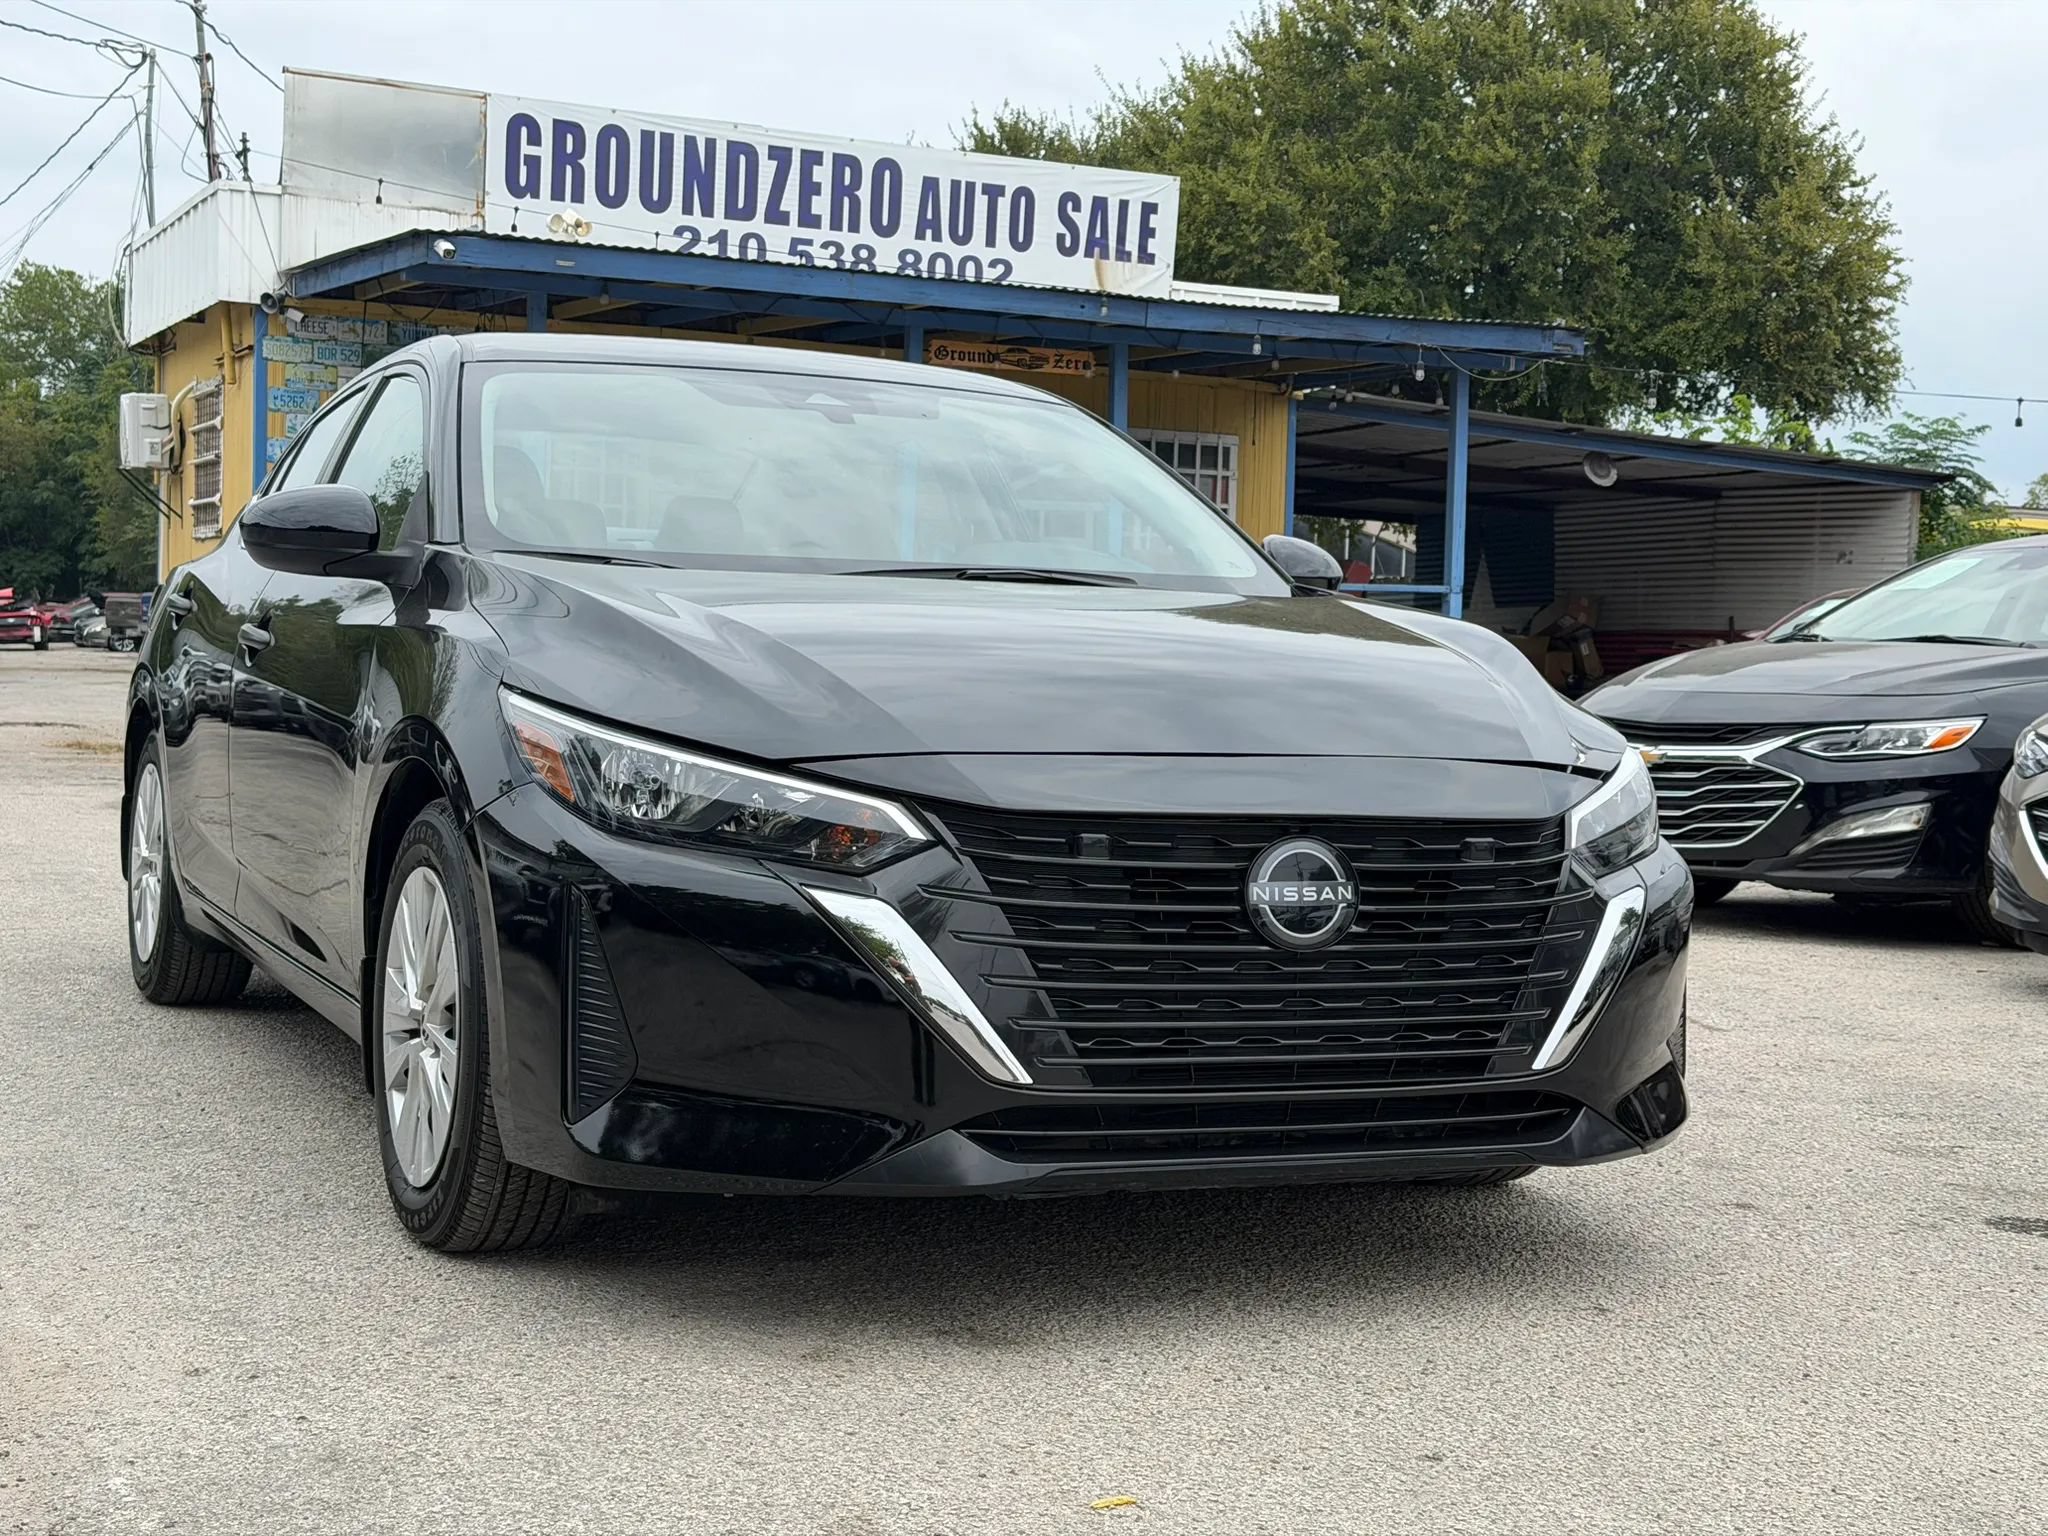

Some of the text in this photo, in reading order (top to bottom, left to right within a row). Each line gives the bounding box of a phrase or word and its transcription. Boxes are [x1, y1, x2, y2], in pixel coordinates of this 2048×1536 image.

[504, 112, 1159, 265] GROUNDZERO AUTO SALE
[673, 224, 1013, 284] 210 538 8002
[340, 347, 360, 362] 529
[934, 344, 1092, 371] Ground Zero
[1252, 885, 1353, 902] NISSAN
